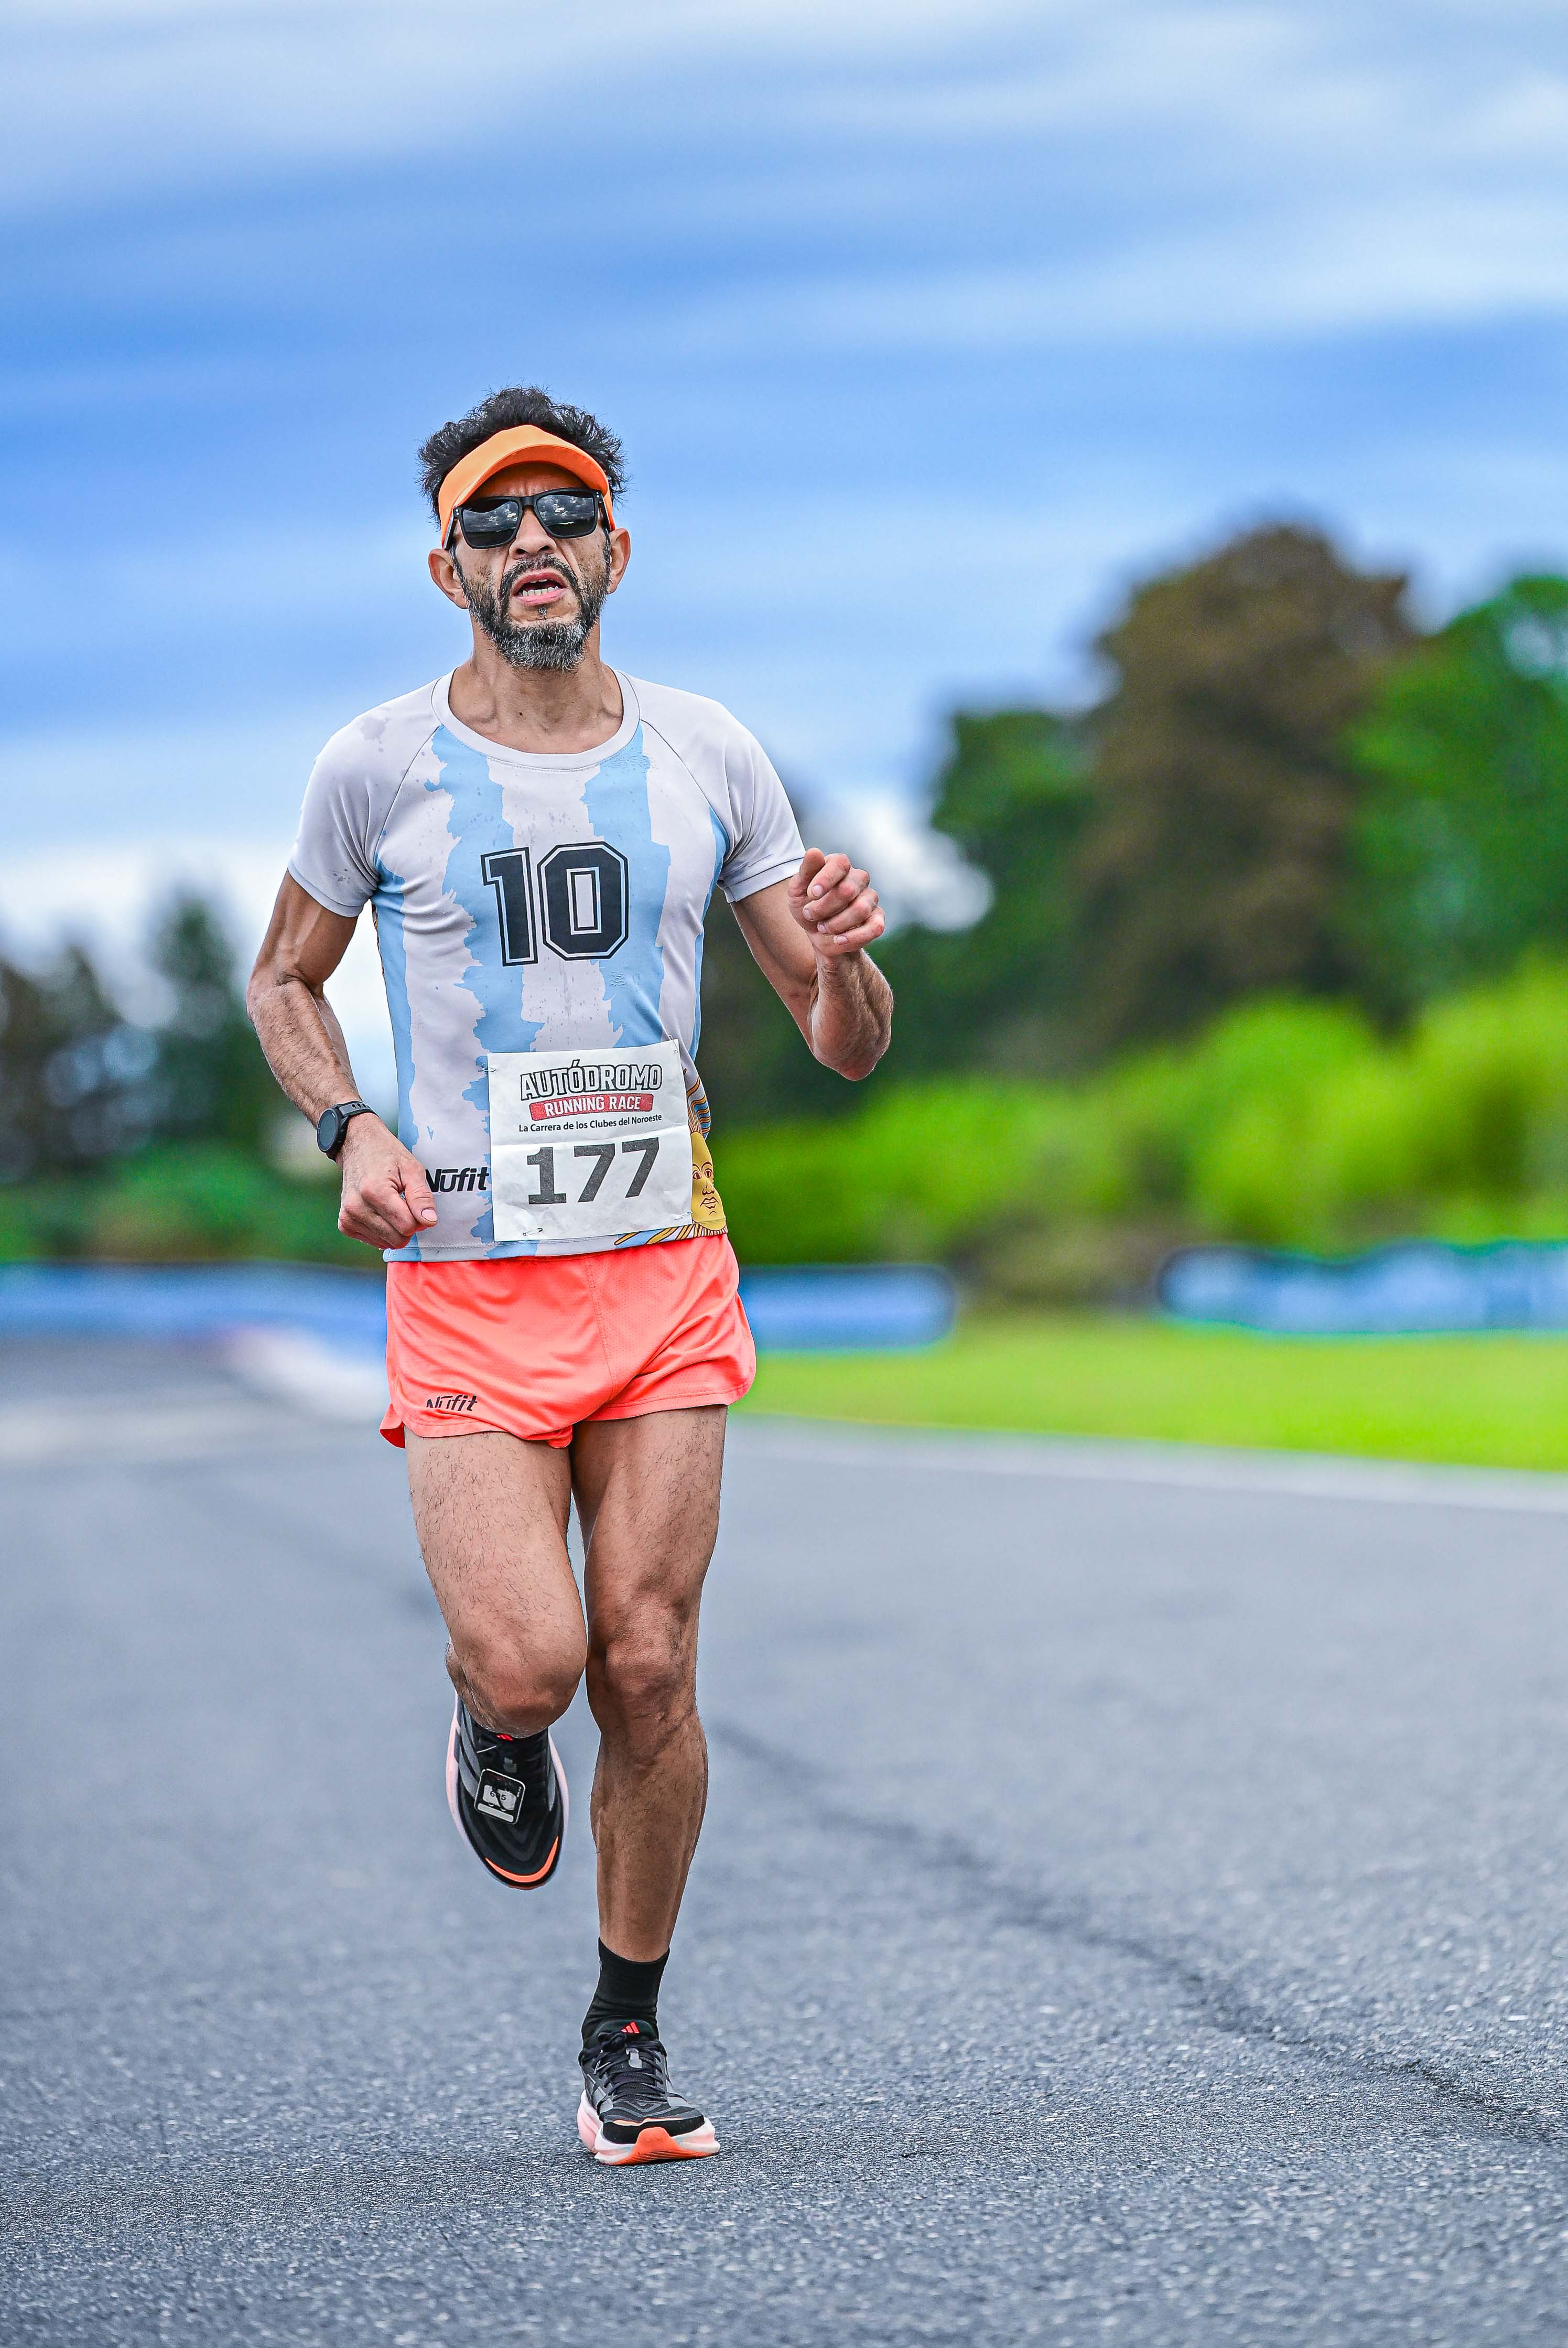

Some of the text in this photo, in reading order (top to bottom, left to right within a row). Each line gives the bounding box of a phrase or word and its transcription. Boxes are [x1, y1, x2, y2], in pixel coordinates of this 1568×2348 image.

[480, 841, 629, 967] 10
[520, 1059, 662, 1101] AUTÓDROMO
[530, 1124, 561, 1132] Carrera
[576, 1121, 588, 1129] los
[589, 1119, 617, 1128] Clubes
[619, 1117, 630, 1126] del
[631, 1114, 662, 1125] Noroeste
[544, 1096, 641, 1117] RUNNING RACE
[526, 1137, 660, 1205] 177
